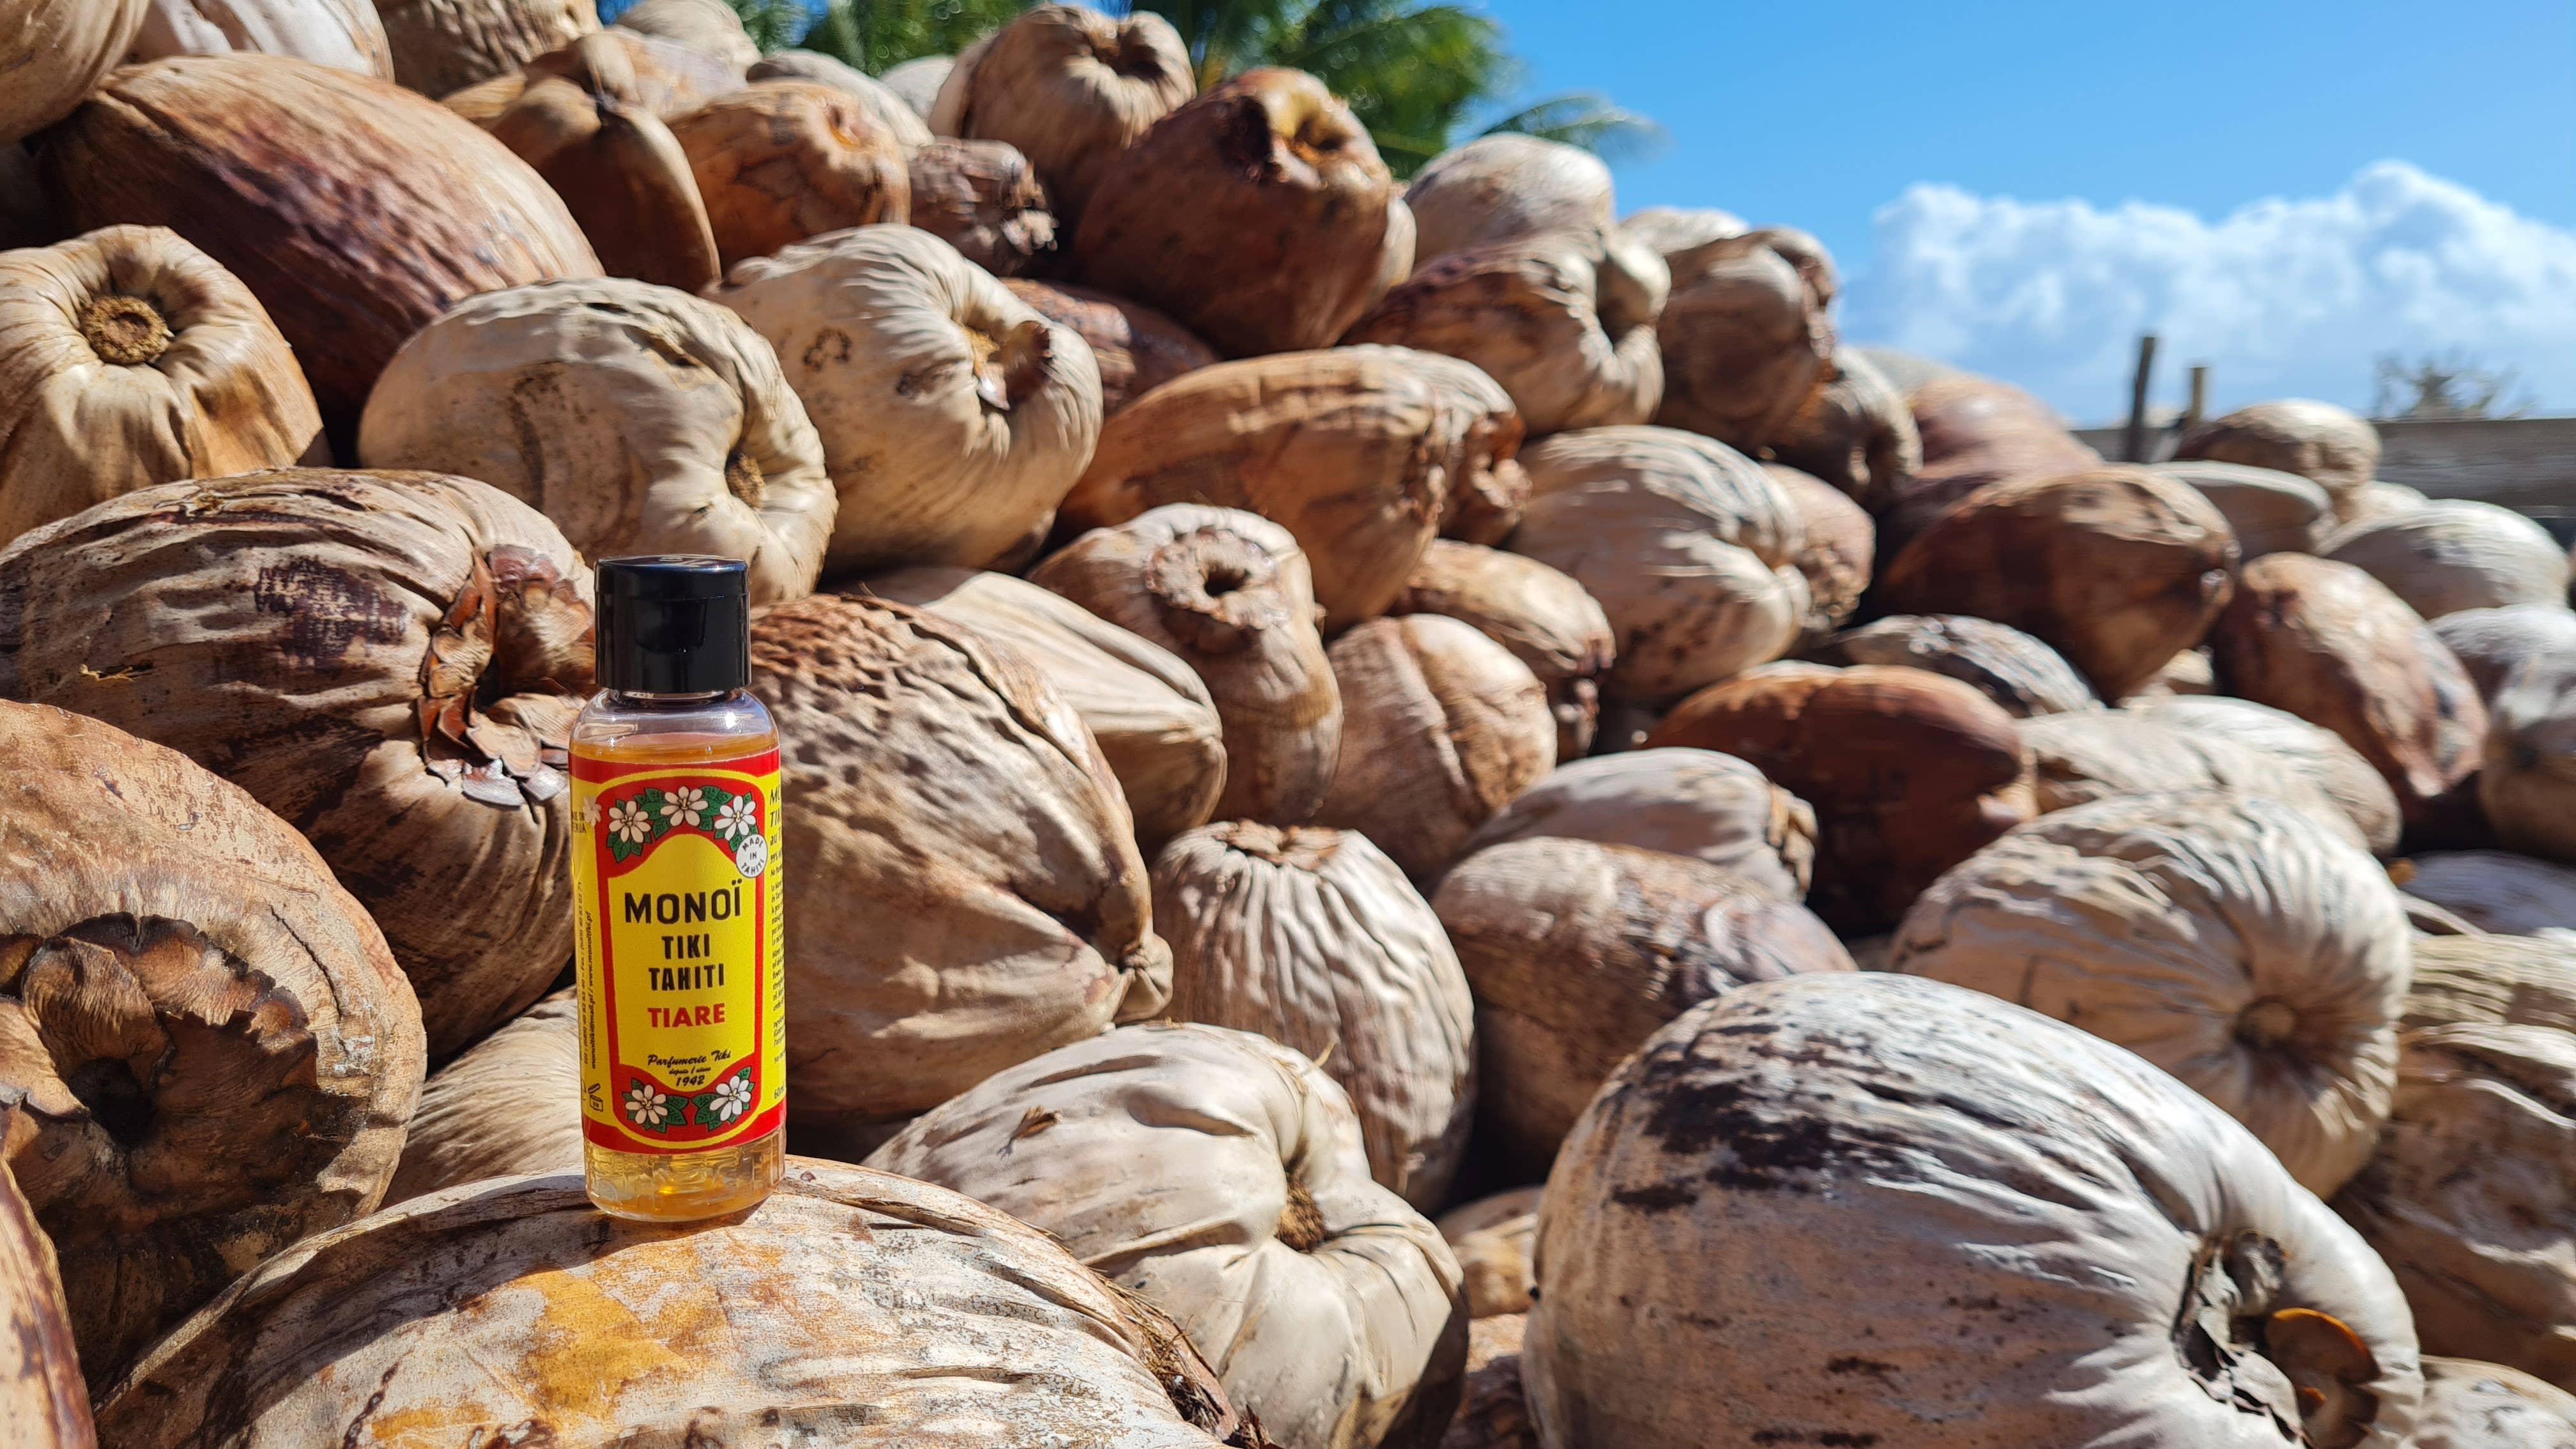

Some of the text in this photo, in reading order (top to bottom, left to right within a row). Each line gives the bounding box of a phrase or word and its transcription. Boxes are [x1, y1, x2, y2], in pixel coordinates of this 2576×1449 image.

[742, 836, 763, 852] MADE
[749, 851, 757, 861] IN
[741, 858, 765, 875] TAHITI
[624, 878, 742, 925] MONOÏ
[661, 933, 710, 960] TIKI
[648, 963, 724, 992] TAHITI
[647, 1002, 726, 1029] TIARE
[647, 1048, 732, 1068] Parfumerie Tiki
[675, 1075, 705, 1087] 1942
